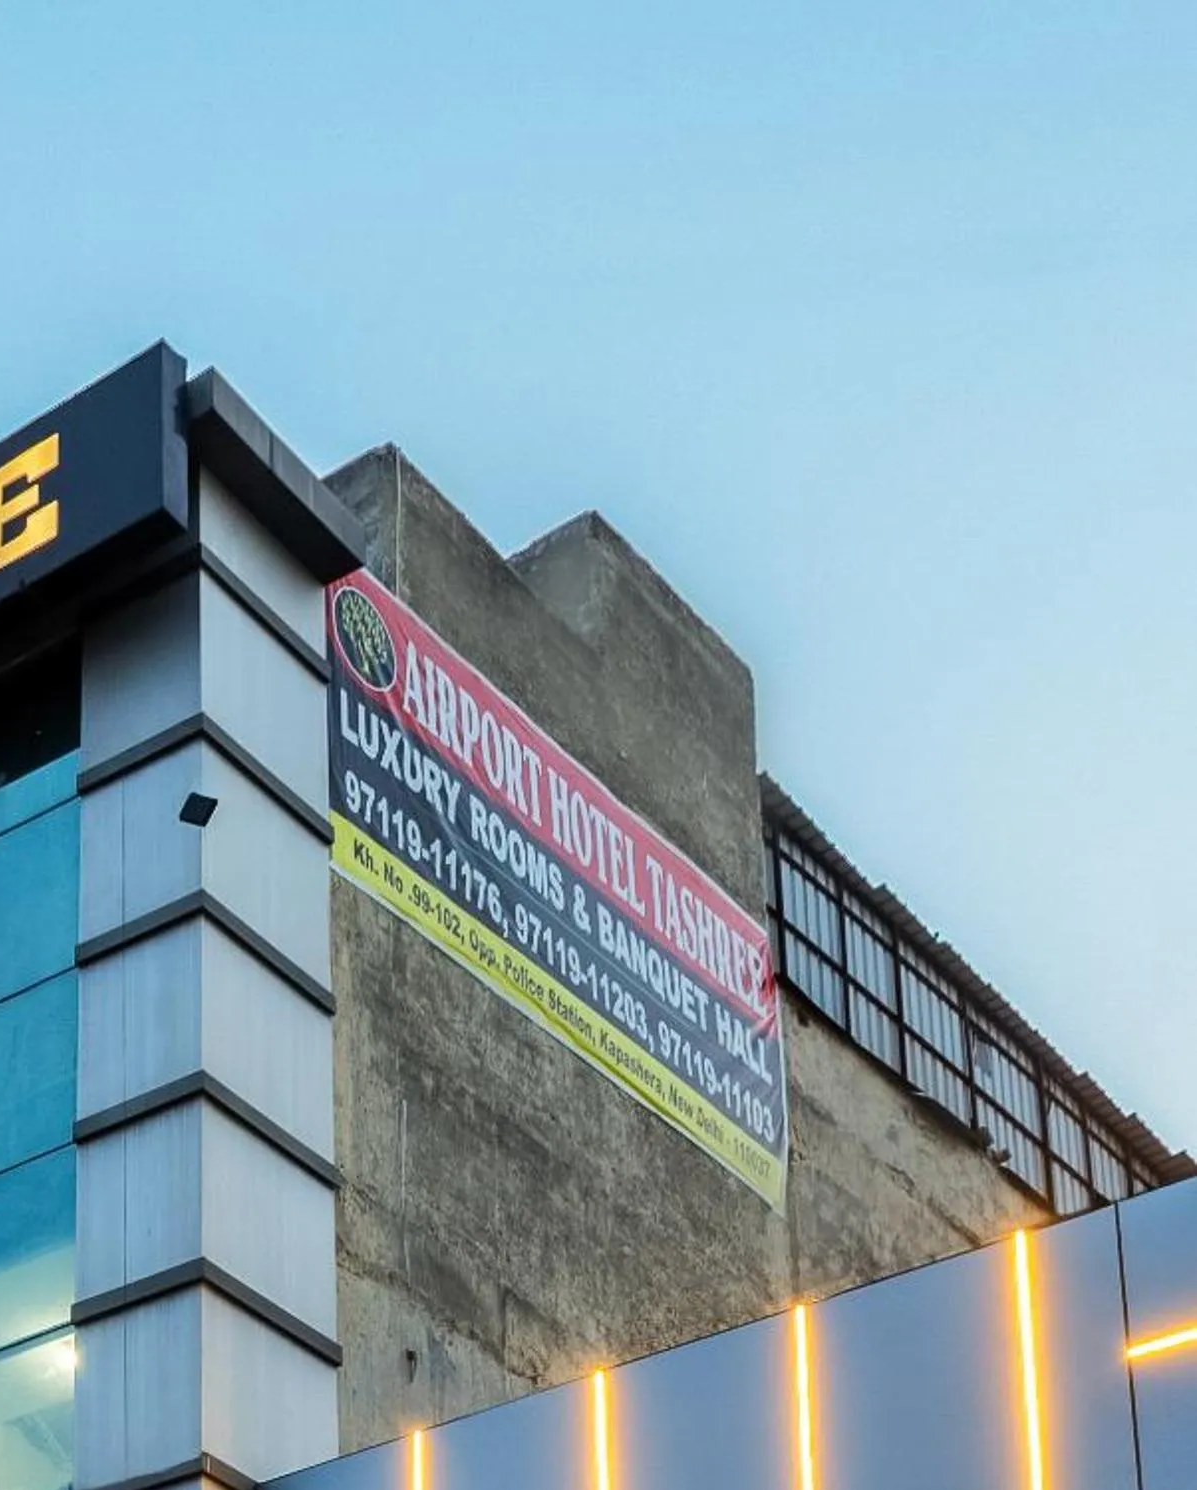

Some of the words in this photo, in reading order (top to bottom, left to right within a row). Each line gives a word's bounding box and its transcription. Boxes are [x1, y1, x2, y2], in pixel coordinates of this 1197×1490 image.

[340, 688, 461, 825] LUXURY
[469, 793, 564, 911] ROOMS
[572, 884, 592, 935] &
[597, 902, 709, 1032] BANQUET
[715, 1003, 773, 1086] HALL
[345, 770, 508, 938] 97119-11176,
[515, 903, 655, 1053] 97119-11203,
[658, 1021, 775, 1143] 97119-11103
[354, 839, 379, 875] Kh.
[504, 955, 544, 1001] Police
[549, 986, 595, 1046] Station,
[600, 1029, 666, 1103] Kapashera,
[669, 1083, 694, 1119] New
[697, 1111, 724, 1145] Delhi
[402, 641, 543, 828] AIRPORT
[547, 766, 646, 917] HOTEL
[646, 859, 769, 1018] TASHREE
